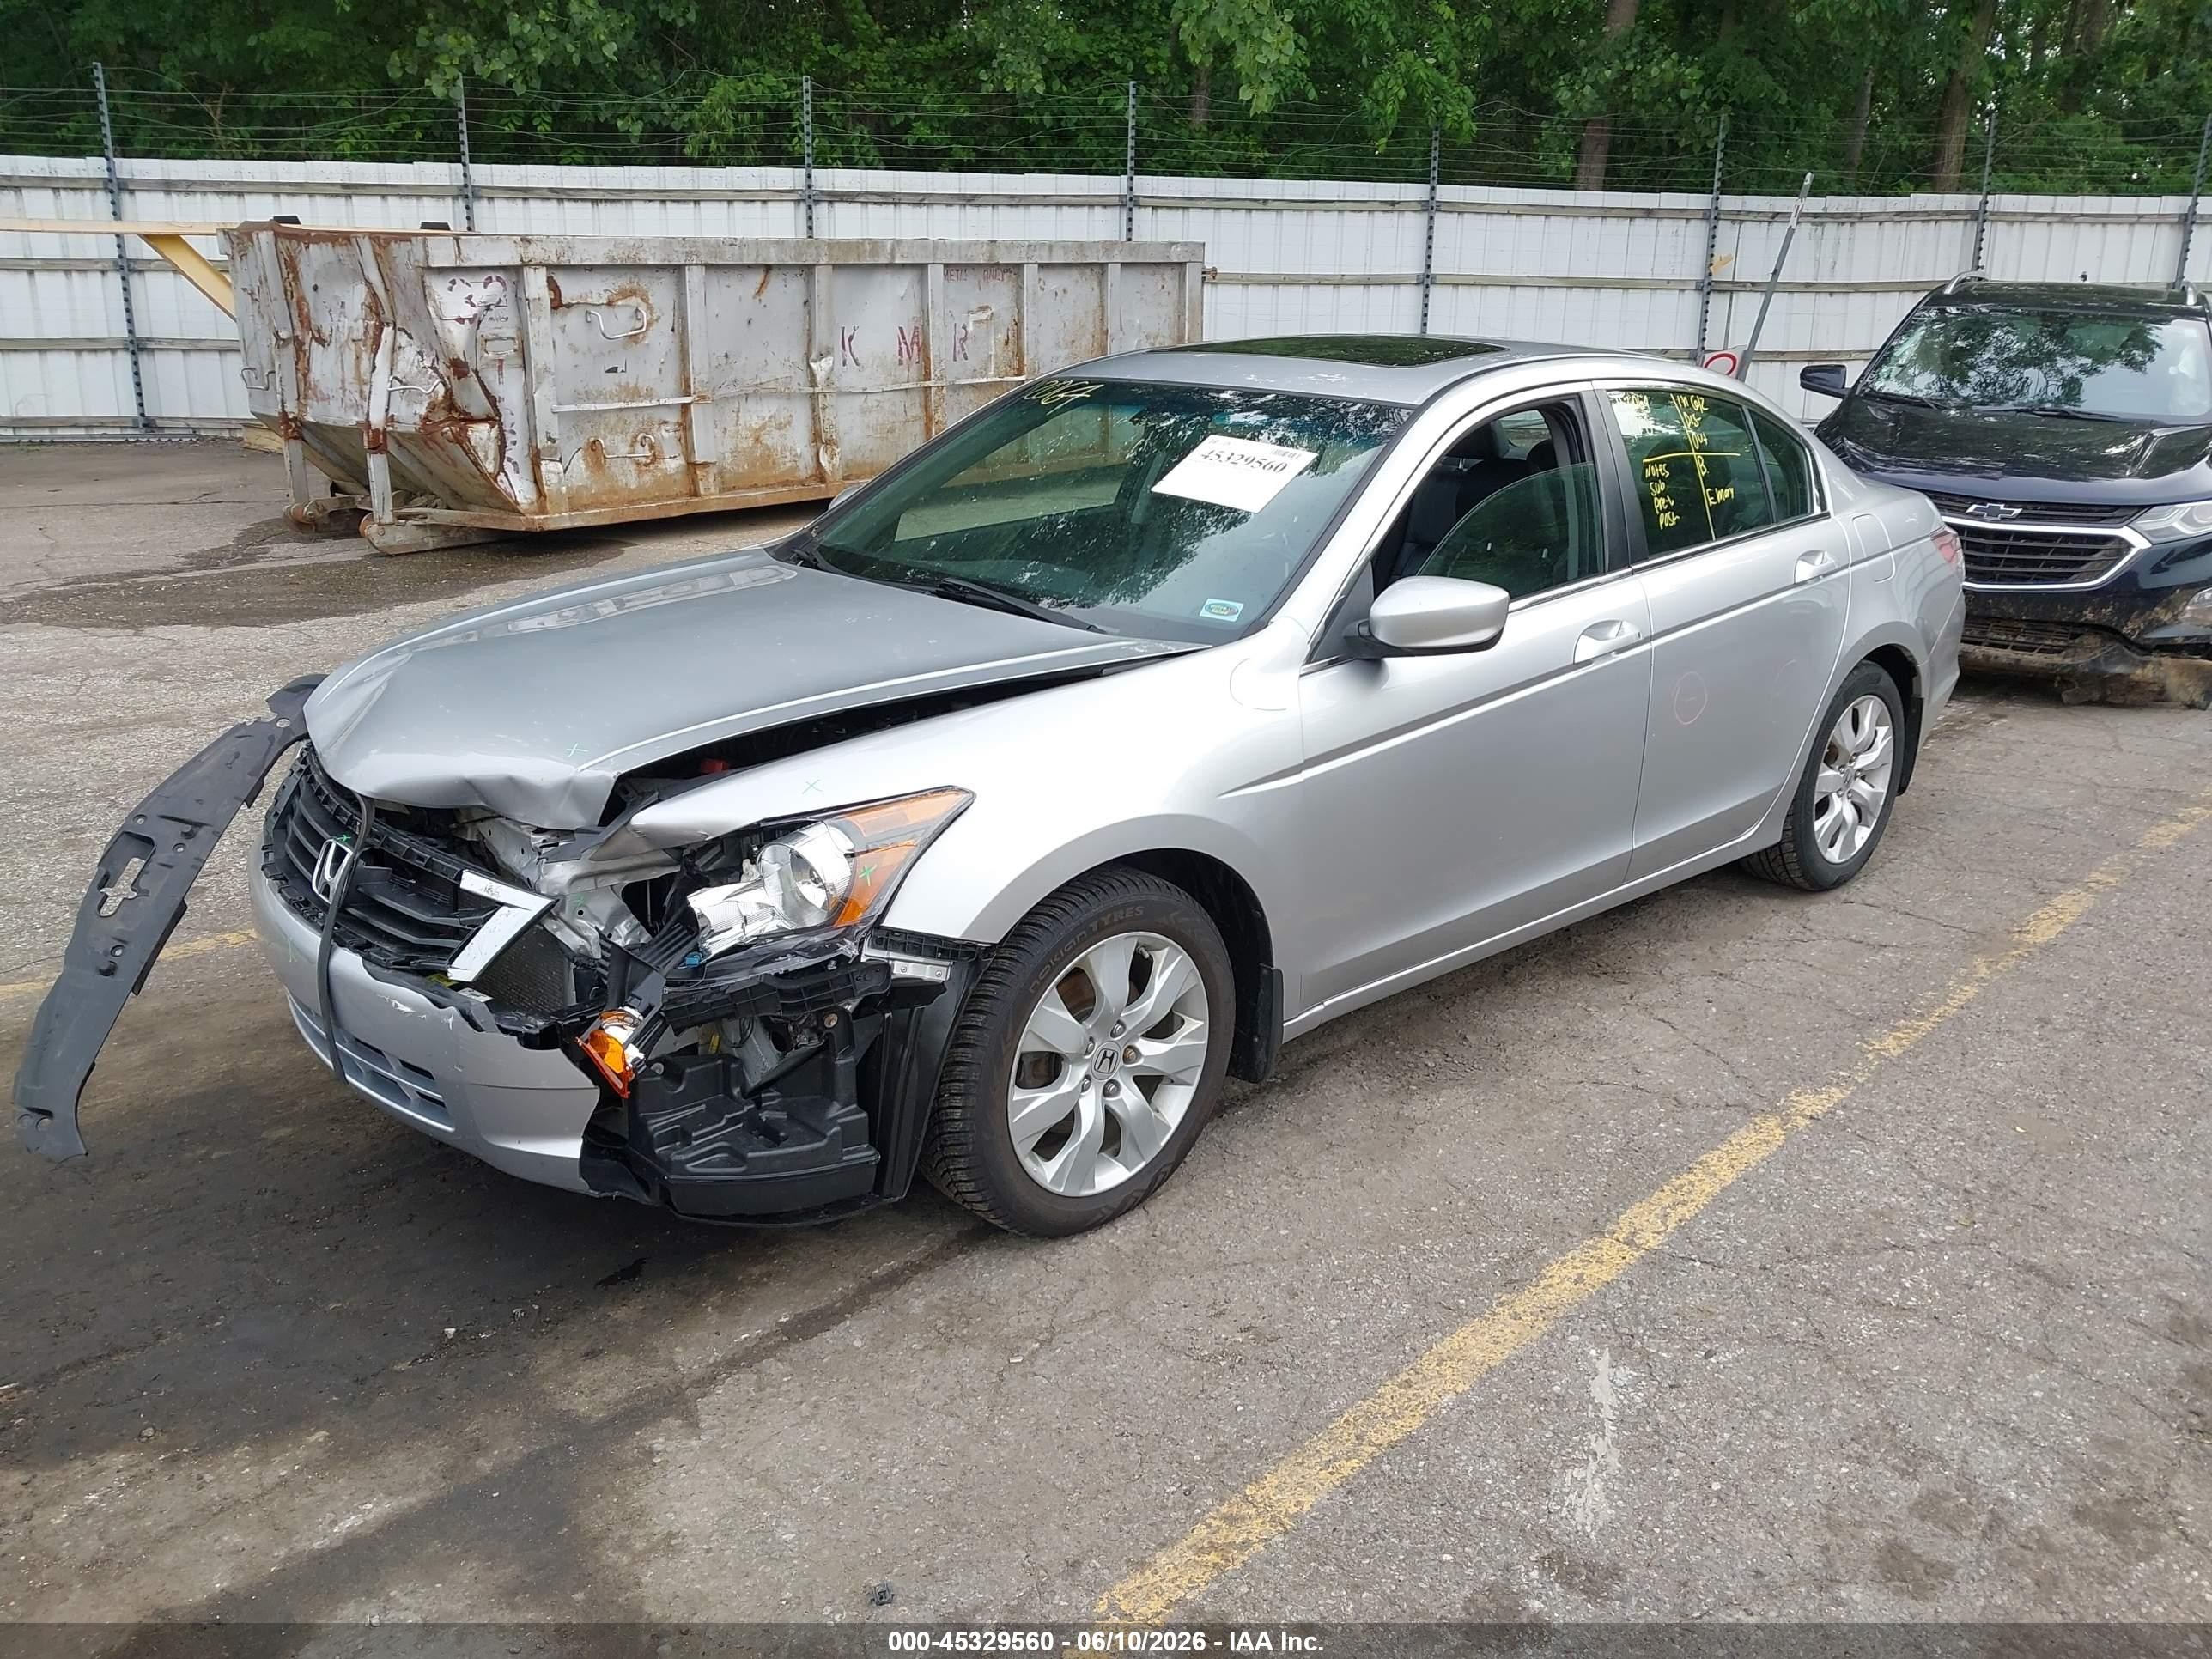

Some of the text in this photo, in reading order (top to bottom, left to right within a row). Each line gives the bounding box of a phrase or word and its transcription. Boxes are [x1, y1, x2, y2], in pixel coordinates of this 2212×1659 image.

[841, 325, 860, 368] K
[897, 325, 921, 366] M
[1200, 449, 1289, 474] 45329560
[1089, 905, 1145, 932] TYRES
